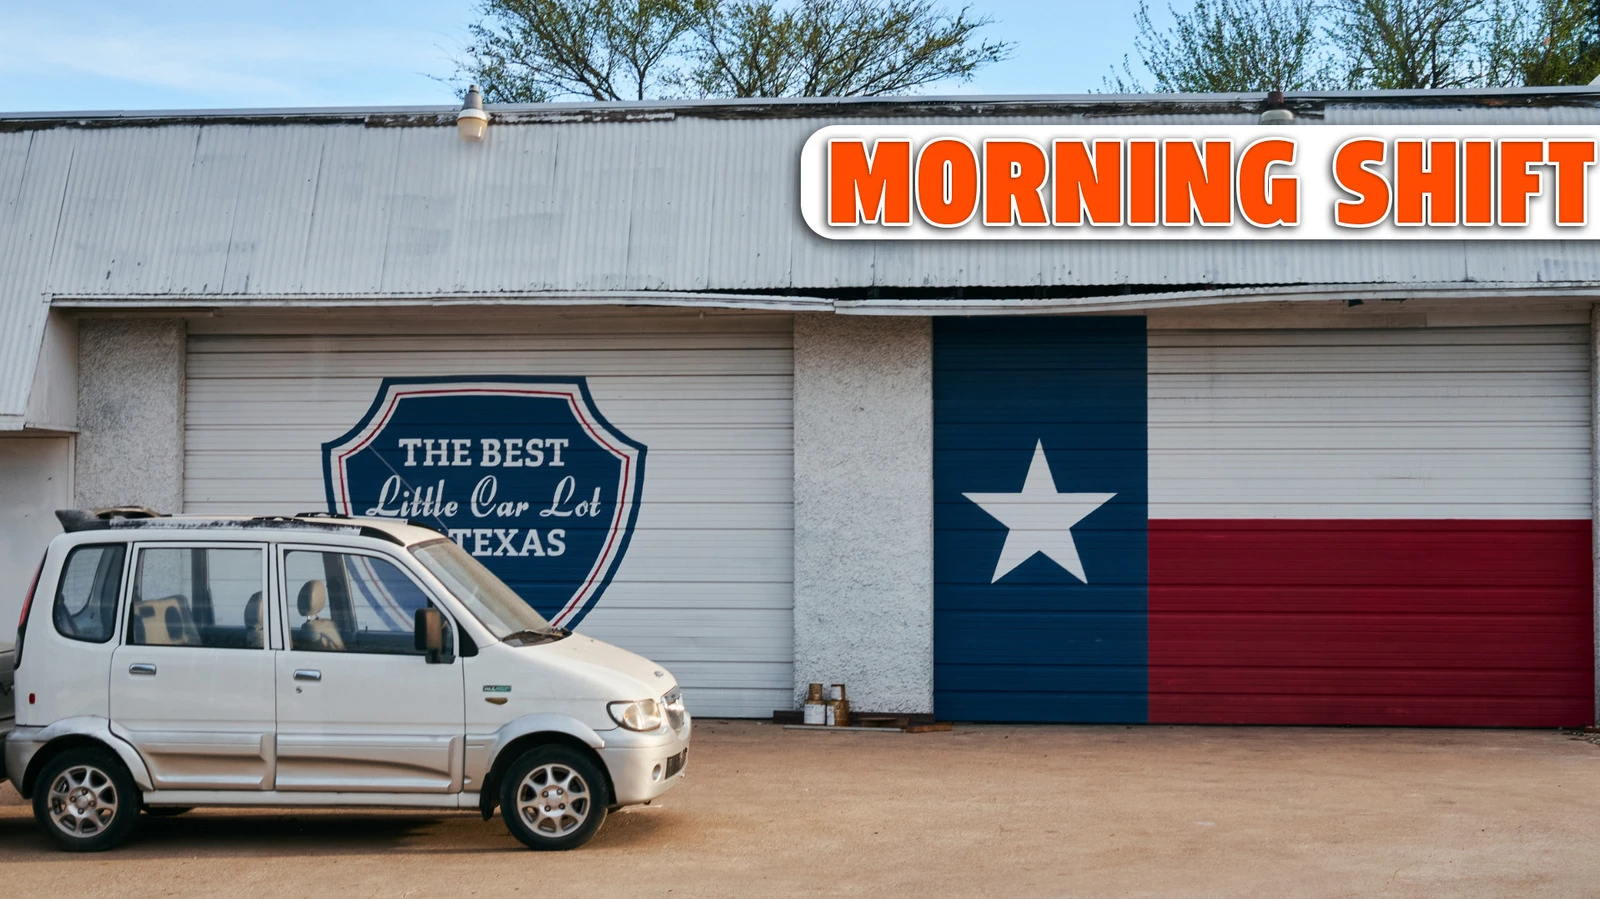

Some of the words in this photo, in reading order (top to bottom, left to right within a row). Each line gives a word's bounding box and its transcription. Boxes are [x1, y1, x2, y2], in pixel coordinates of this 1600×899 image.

[399, 439, 472, 467] THE
[480, 439, 569, 467] BEST
[366, 475, 458, 518] Little
[471, 475, 529, 518] Car
[540, 476, 602, 518] Lot
[448, 529, 566, 556] TEXAS
